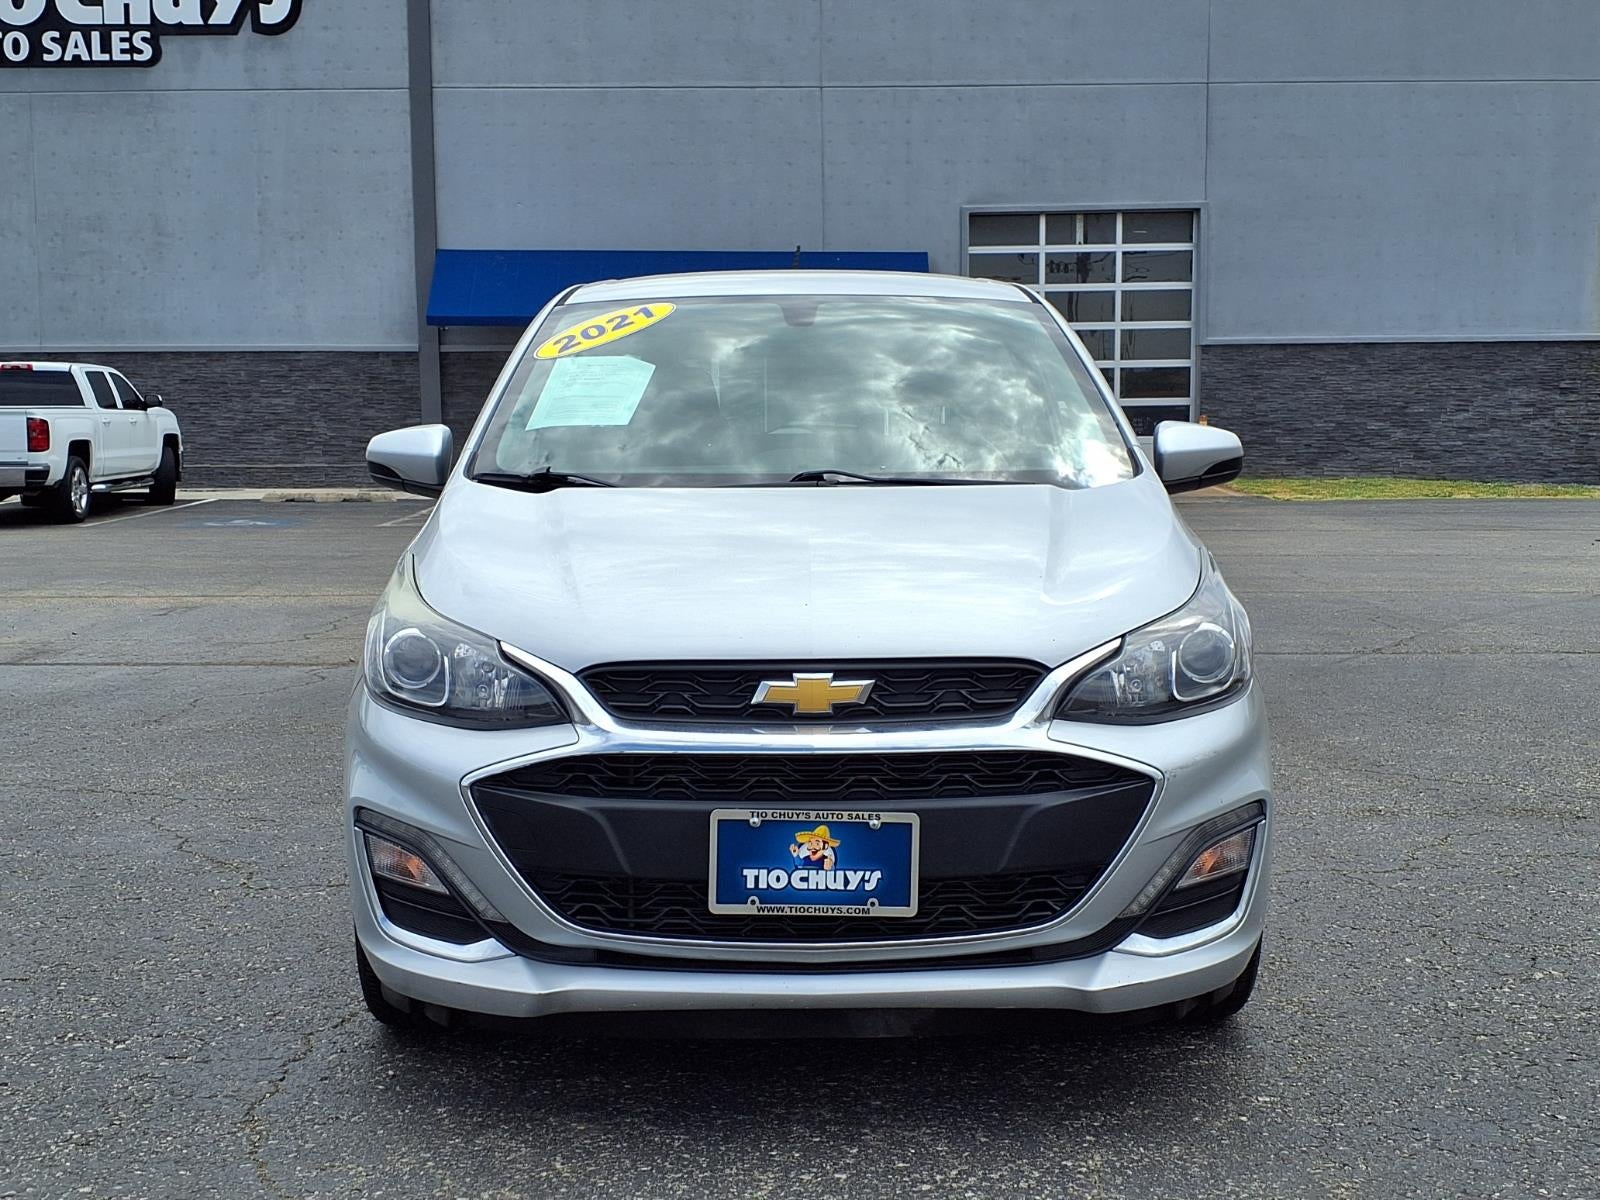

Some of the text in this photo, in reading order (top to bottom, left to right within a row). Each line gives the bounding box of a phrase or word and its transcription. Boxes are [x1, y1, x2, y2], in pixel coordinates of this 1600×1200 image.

[41, 31, 153, 62] SALES
[553, 307, 655, 354] 2021
[750, 811, 881, 821] TIO CHUY'S AUTO SALES
[756, 905, 871, 915] WWW.TIOCHUYS.COM
